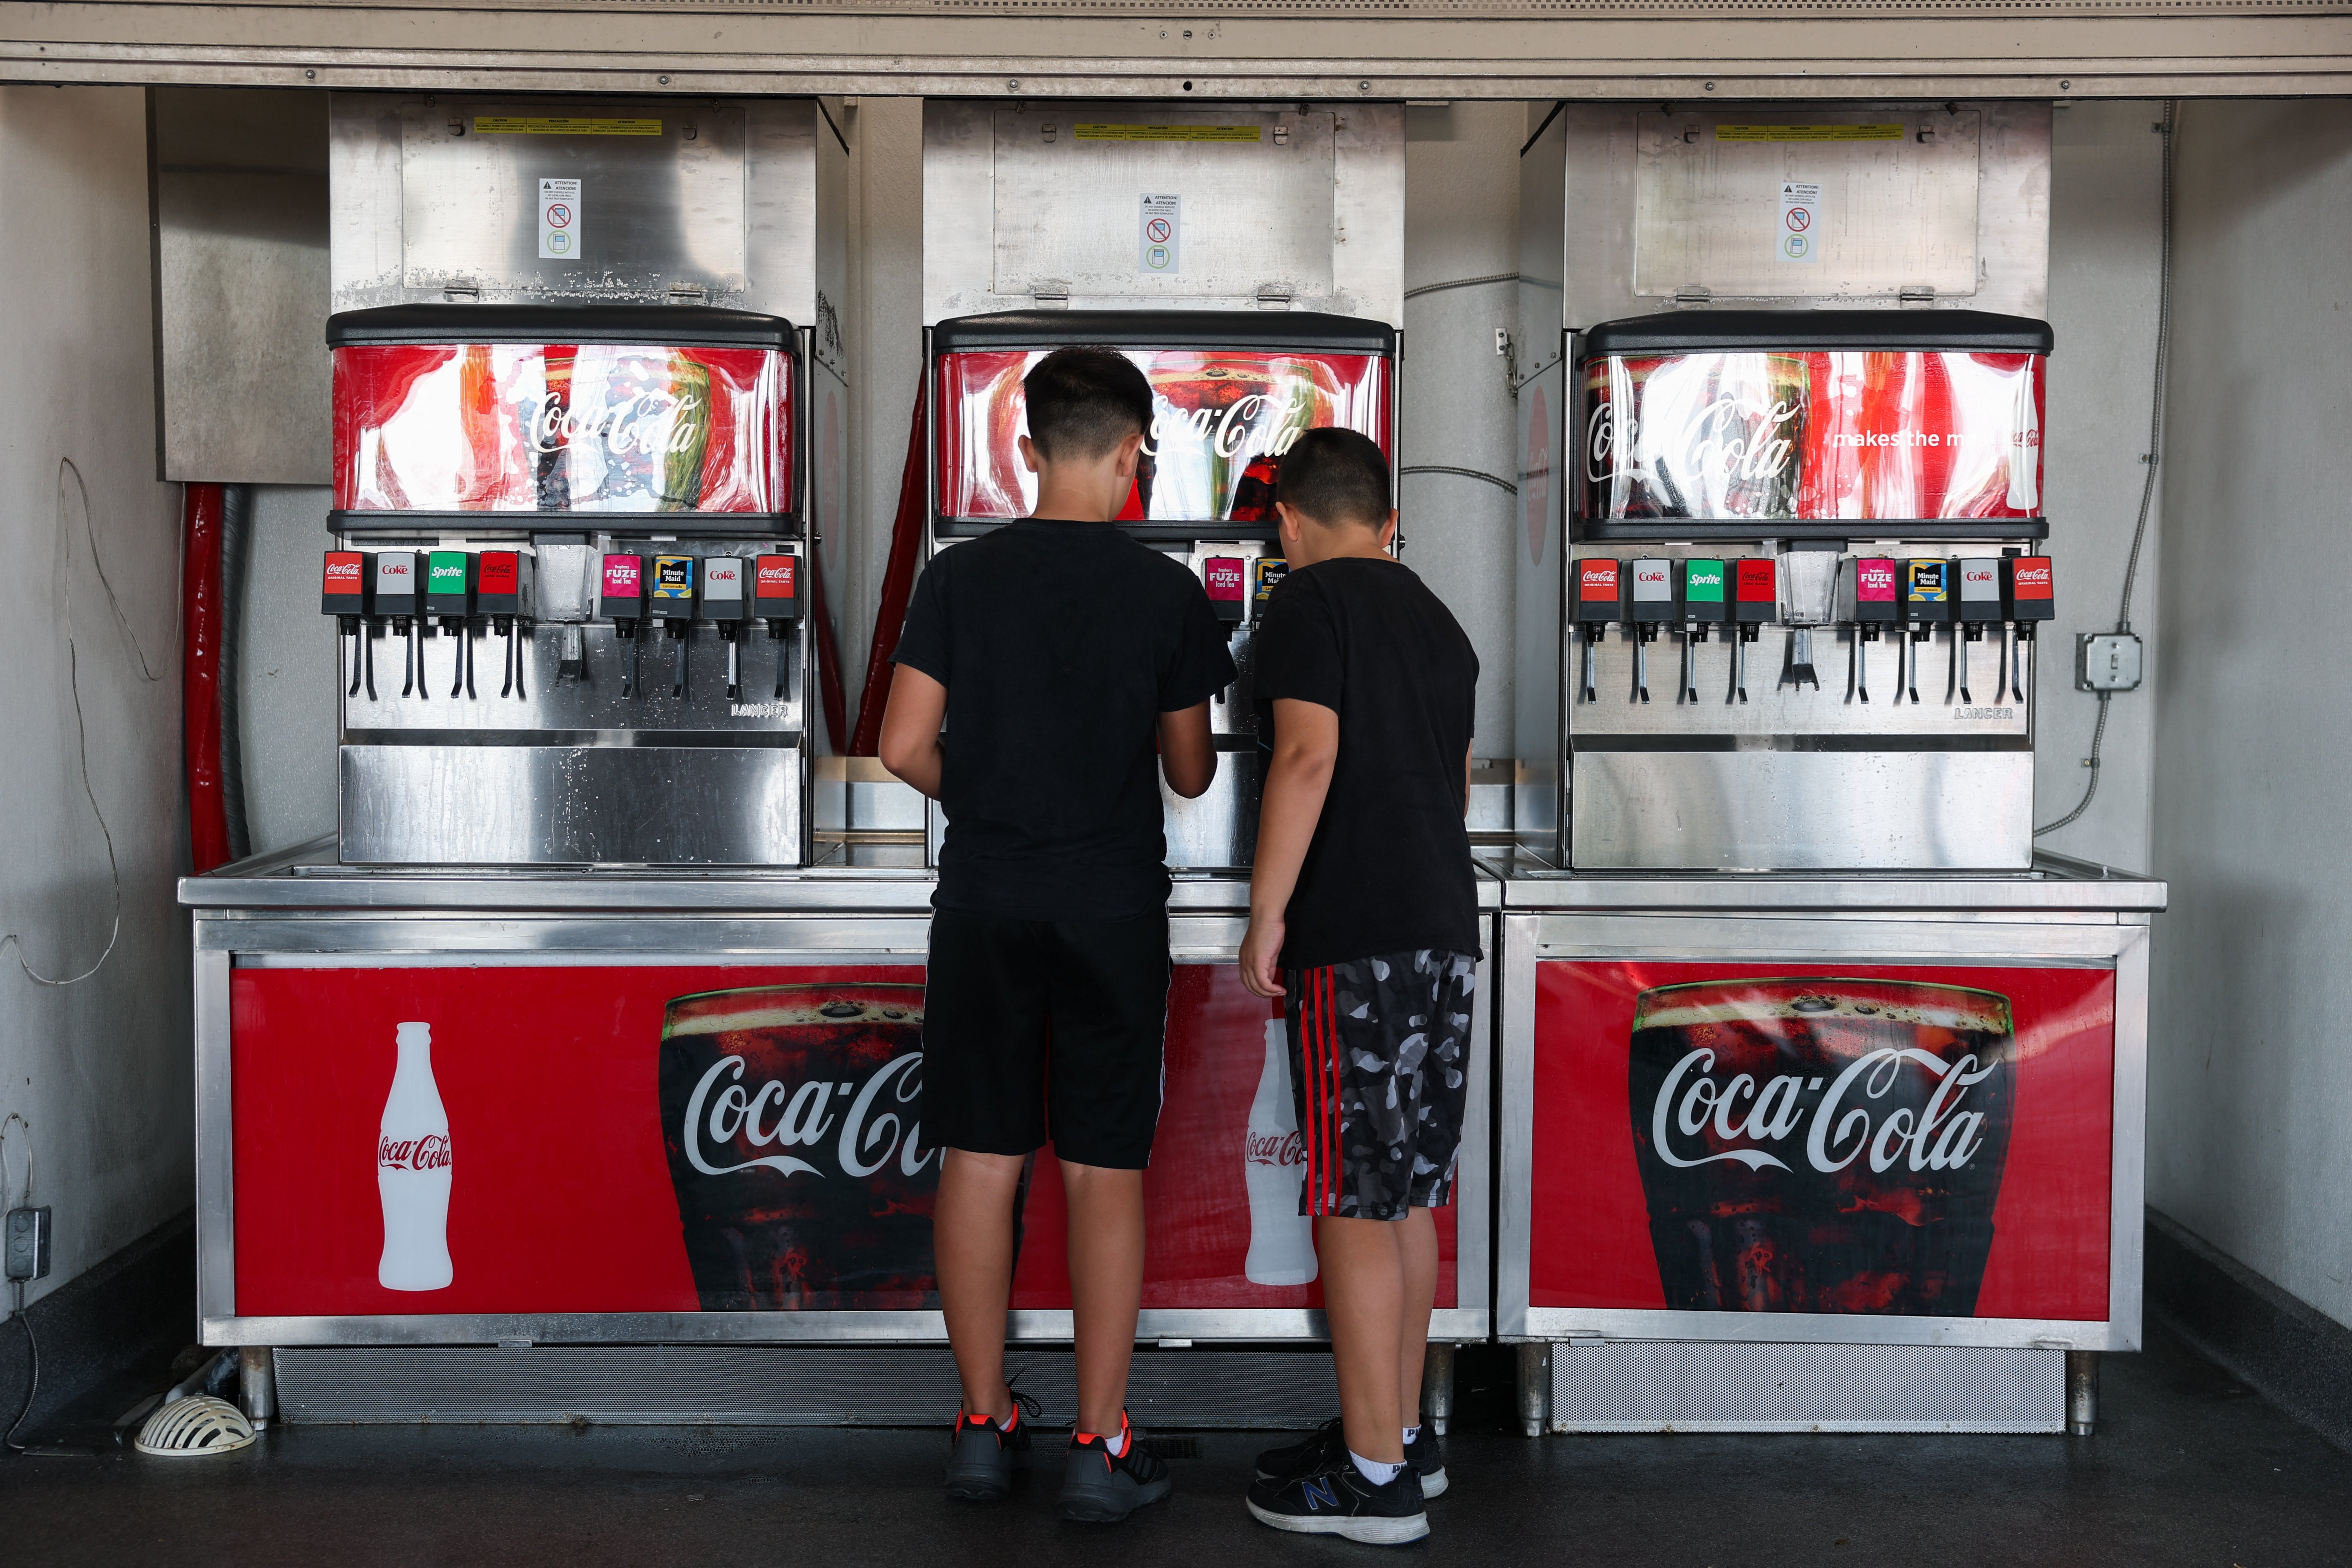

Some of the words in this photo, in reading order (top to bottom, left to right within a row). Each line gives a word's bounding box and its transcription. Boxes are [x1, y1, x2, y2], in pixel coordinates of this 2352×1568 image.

[530, 392, 702, 455] Coca-Cola
[1833, 430, 1899, 447] makes
[1908, 430, 1940, 446] the
[327, 564, 361, 575] Coca-Cola
[382, 565, 408, 574] Coke
[431, 567, 462, 578] Sprite
[484, 564, 511, 573] Coca-Cola
[759, 567, 792, 578] Coca-Cola
[710, 571, 735, 580] Coke
[1209, 573, 1240, 581] FUZE
[1583, 571, 1616, 582] Coca-Cola
[1639, 572, 1664, 581] Coke
[1690, 574, 1720, 586] Sprite
[1742, 572, 1770, 581] Coca-Cola
[1861, 573, 1892, 582] FUZE
[1967, 572, 1992, 581] Coke
[2017, 569, 2050, 580] Coca-Cola
[732, 704, 788, 717] LANCER
[1955, 708, 2013, 719] LANCER
[684, 1052, 946, 1178] Coca-Co
[1652, 1048, 1998, 1173] Coca-Cola
[379, 1135, 451, 1171] Coca-Cola
[1246, 1131, 1303, 1167] Coca-Co
[1302, 1477, 1339, 1510] N
